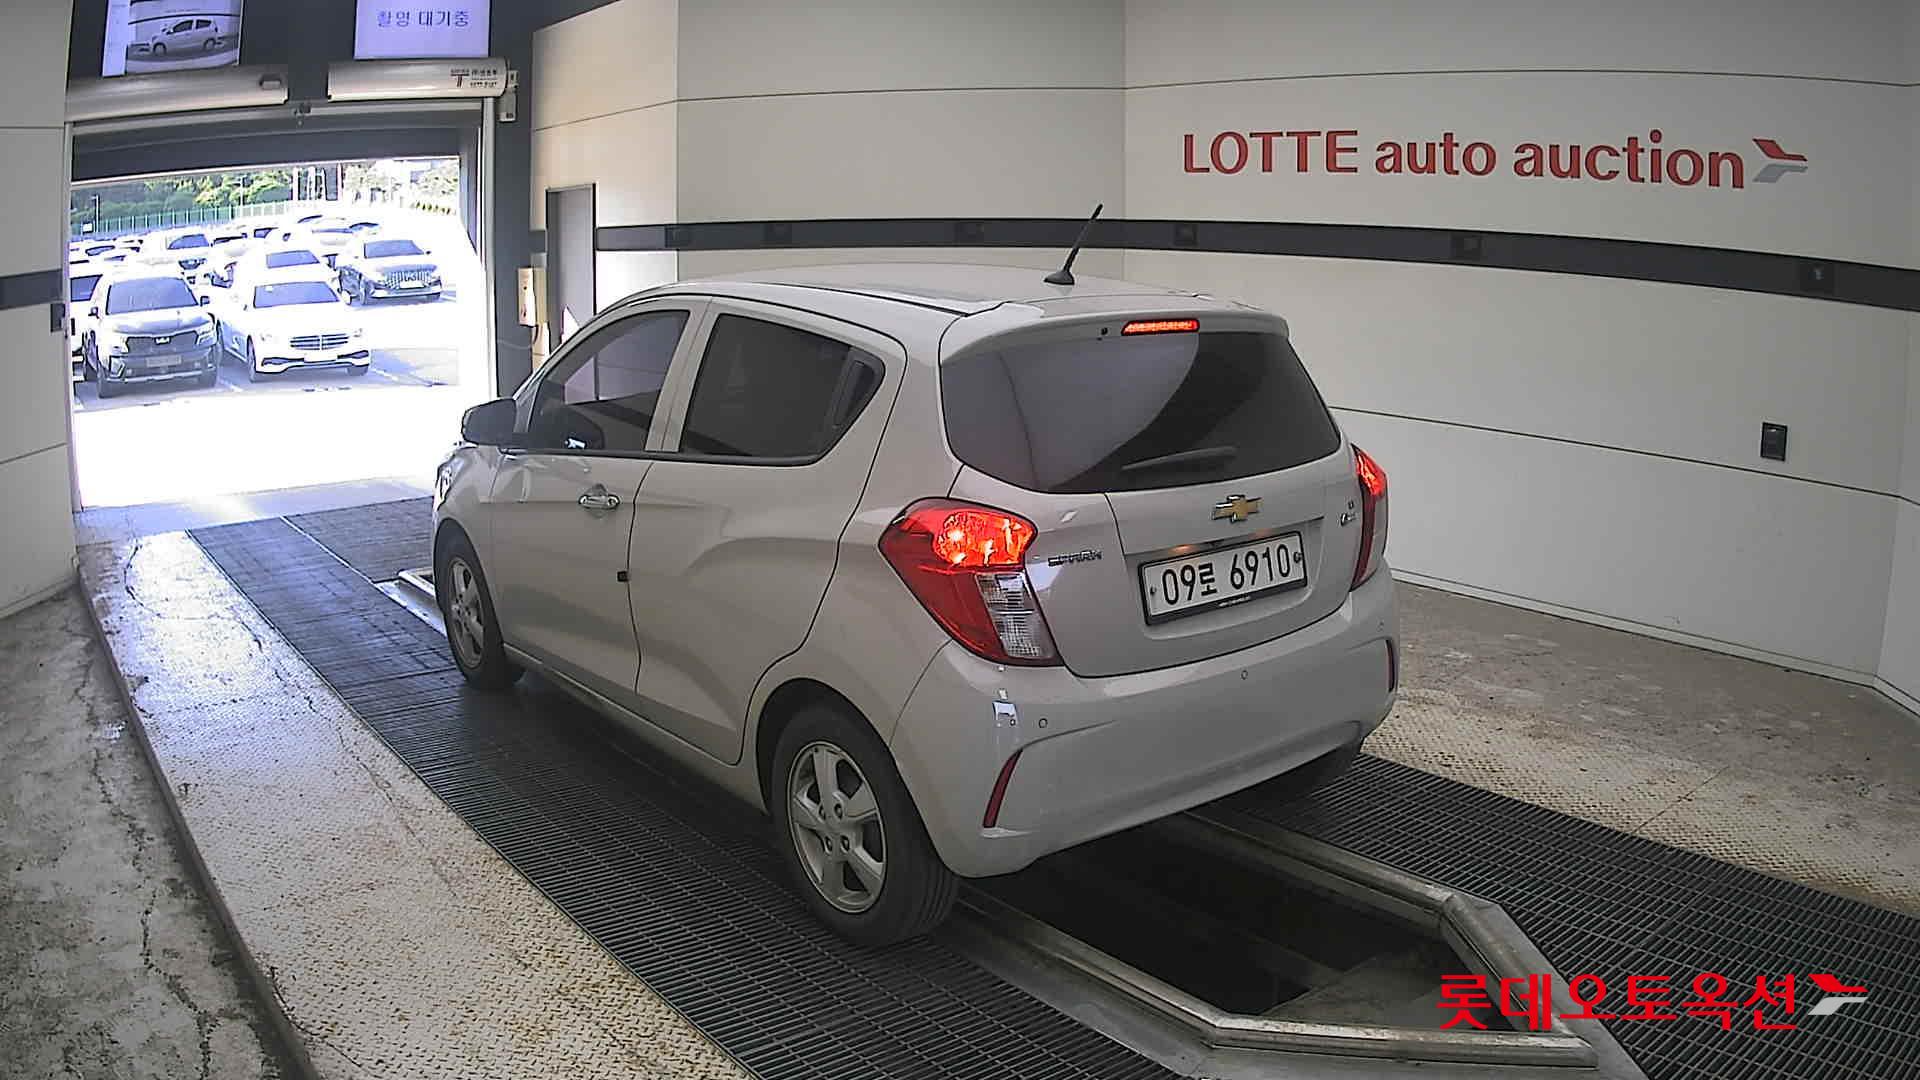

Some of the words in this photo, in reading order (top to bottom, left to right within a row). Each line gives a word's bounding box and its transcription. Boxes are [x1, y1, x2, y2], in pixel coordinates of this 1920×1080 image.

[418, 10, 469, 27] 대기중
[1183, 129, 1359, 174] LOTTE
[1375, 132, 1497, 177] auto
[1513, 129, 1745, 189] auction
[1161, 562, 1218, 606] 09로
[1229, 543, 1291, 591] 6910
